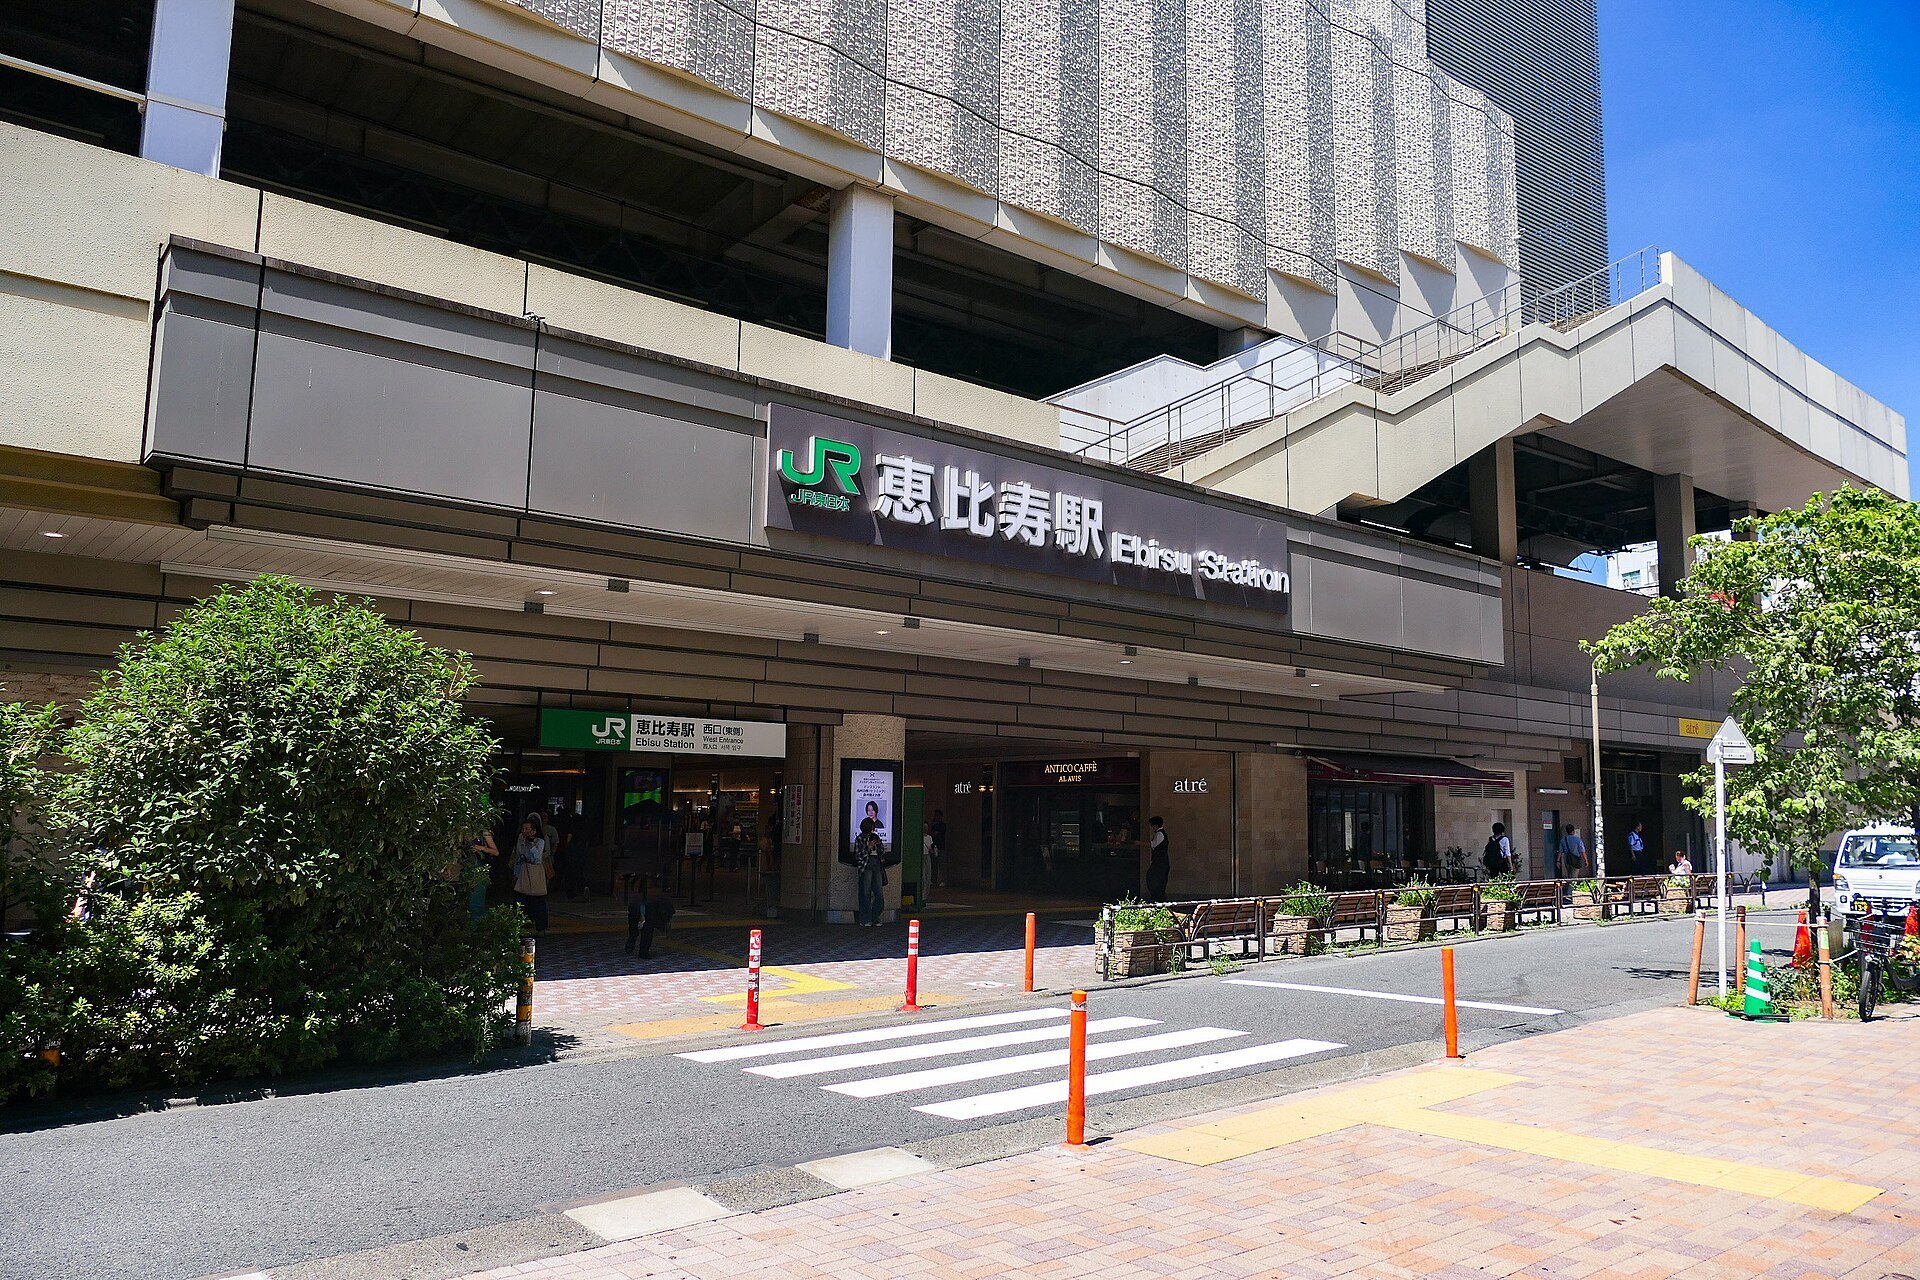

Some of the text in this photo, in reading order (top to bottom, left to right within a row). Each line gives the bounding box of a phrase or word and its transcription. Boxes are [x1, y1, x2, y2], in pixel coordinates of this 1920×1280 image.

[777, 435, 861, 495] JR
[790, 488, 850, 512] JR東日本
[873, 453, 1104, 559] 恵比寿駅
[1112, 531, 1290, 594] Ebisu Station
[591, 717, 627, 739] JR
[635, 719, 695, 738] 恵比寿駅
[635, 738, 695, 749] Ebisu Station
[719, 736, 744, 744] Entrance
[1044, 760, 1097, 774] ANTICO CAFFÈ
[954, 781, 972, 794] atré
[1174, 778, 1208, 792] atré
